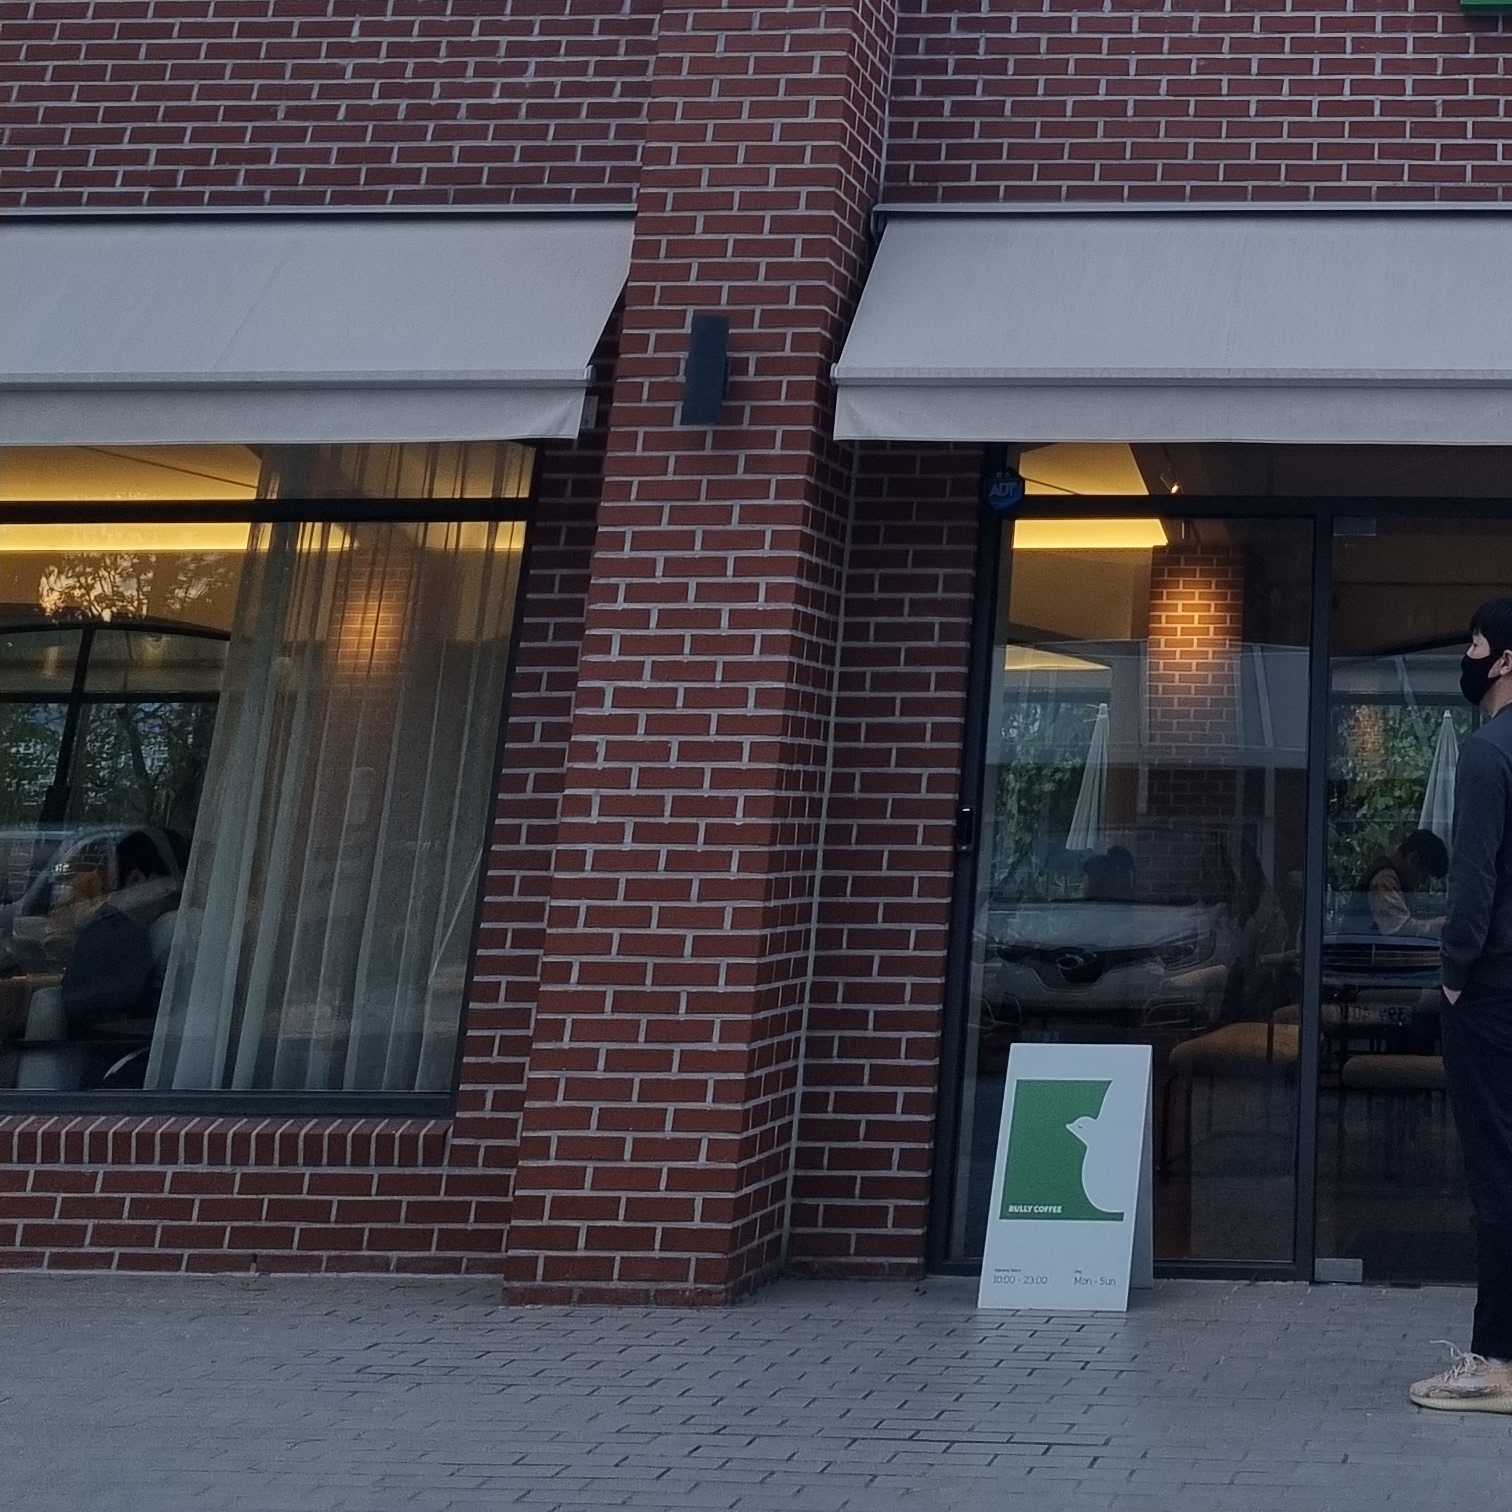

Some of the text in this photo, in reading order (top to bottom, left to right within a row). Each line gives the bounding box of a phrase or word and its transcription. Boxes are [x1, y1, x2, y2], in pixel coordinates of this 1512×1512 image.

[988, 482, 1017, 497] ADT
[1008, 1204, 1063, 1214] RULLY COFFEE
[993, 1275, 1016, 1285] 10:00
[1023, 1275, 1048, 1285] 23:00
[1073, 1276, 1092, 1286] Mon
[1099, 1276, 1116, 1286] Sun
